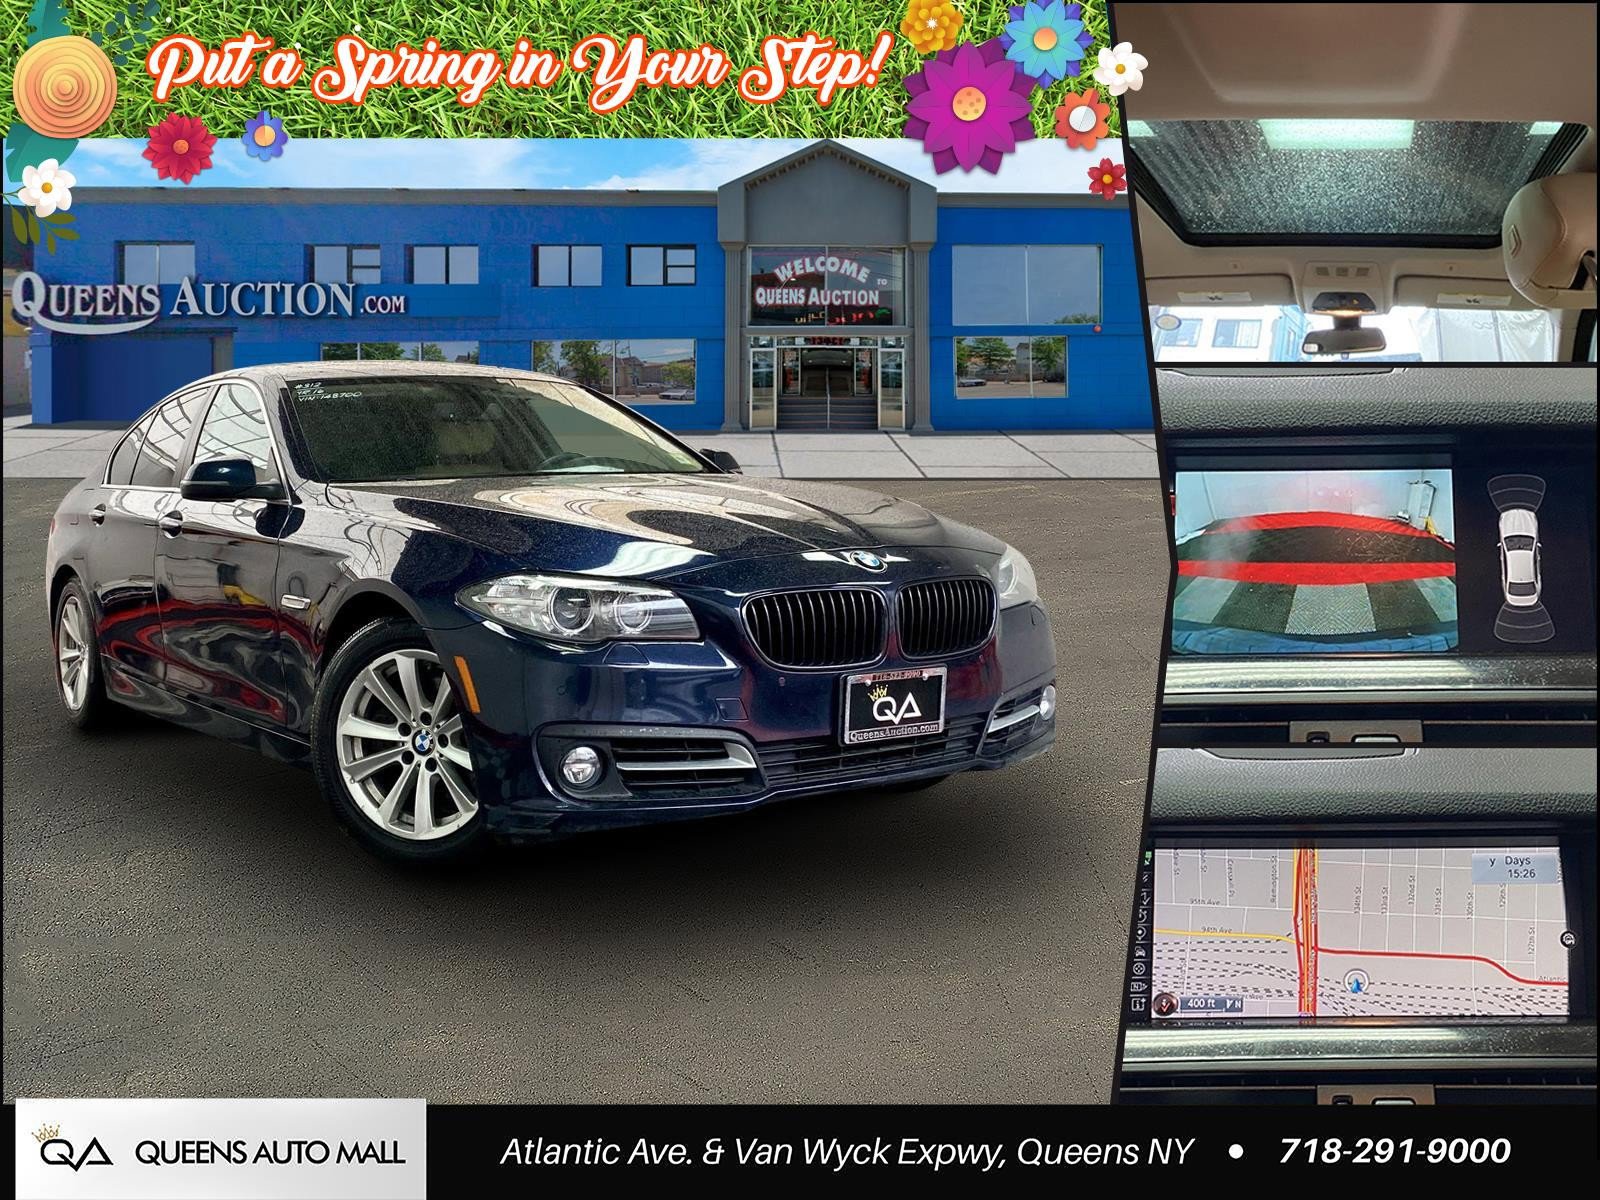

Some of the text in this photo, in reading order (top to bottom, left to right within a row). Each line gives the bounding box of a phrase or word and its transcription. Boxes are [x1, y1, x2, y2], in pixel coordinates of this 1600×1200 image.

[774, 256, 871, 284] WELCOME
[10, 271, 161, 326] QUEENS
[755, 287, 880, 306] QUEENS AUCTION
[873, 692, 922, 725] QA
[850, 724, 939, 741] QueensAuction.com
[1505, 856, 1531, 867] Days
[1408, 875, 1415, 883] St
[1508, 868, 1536, 879] 15:26
[1354, 886, 1361, 895] St
[1188, 998, 1216, 1008] 400 ft
